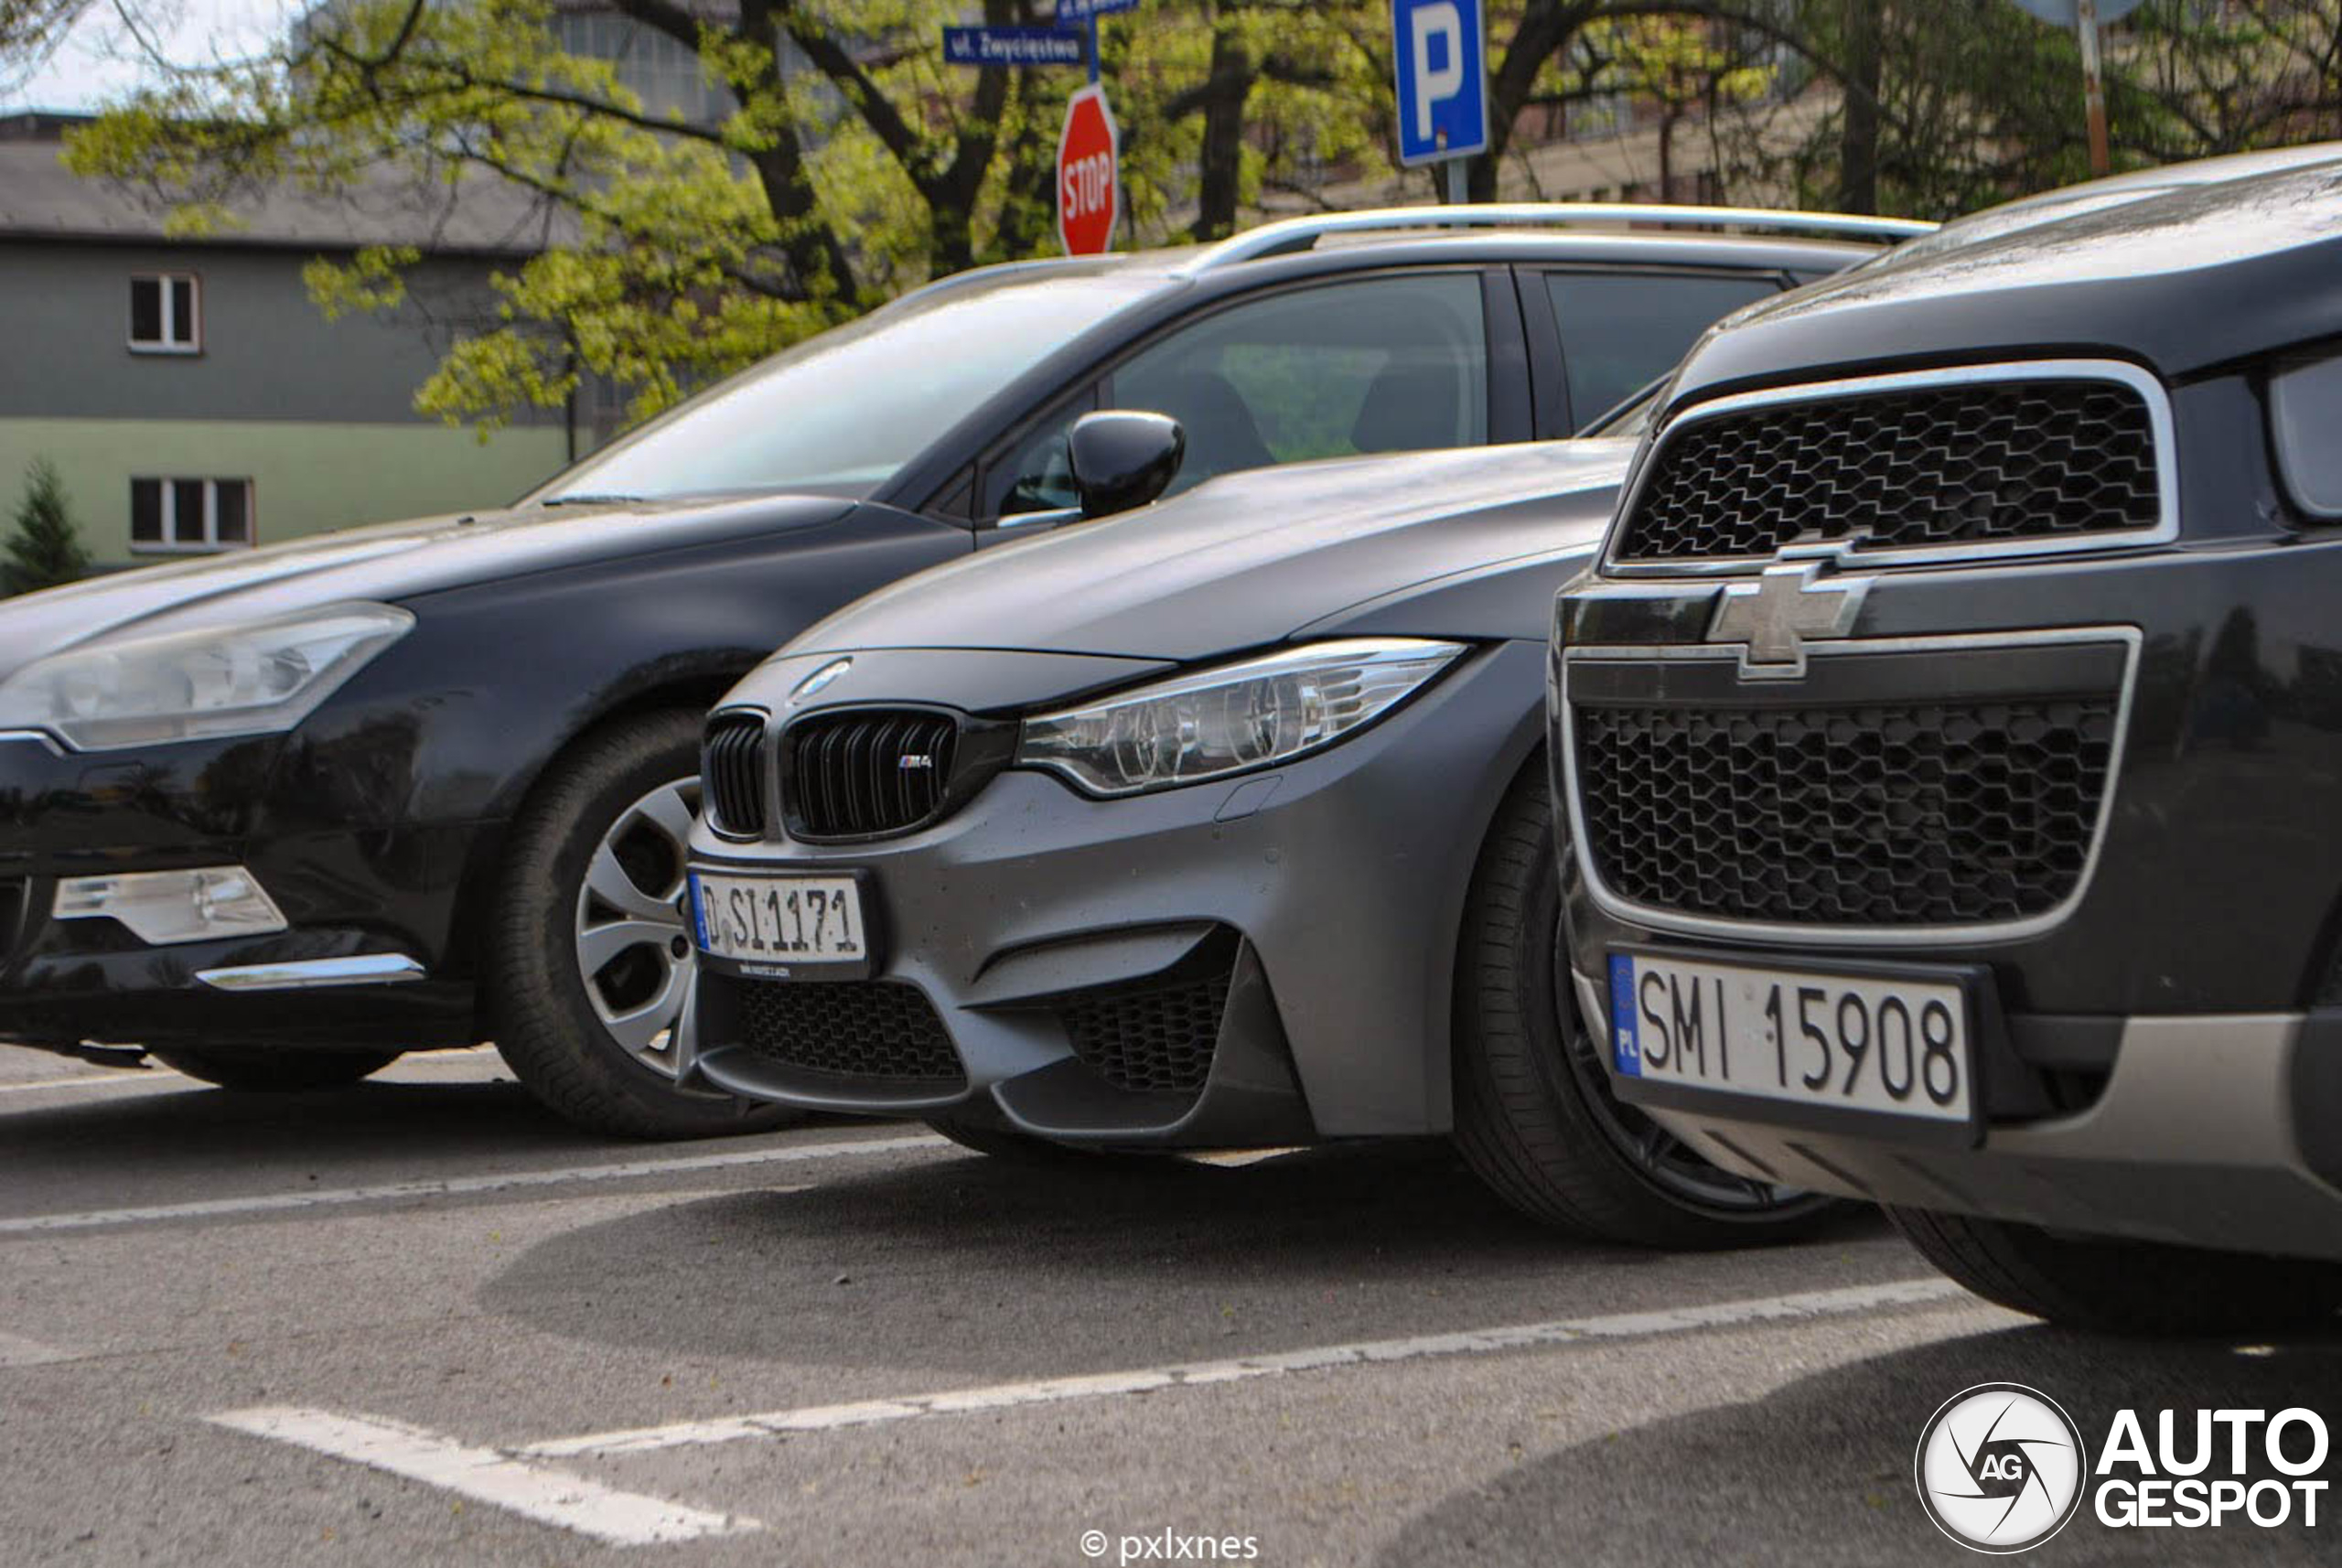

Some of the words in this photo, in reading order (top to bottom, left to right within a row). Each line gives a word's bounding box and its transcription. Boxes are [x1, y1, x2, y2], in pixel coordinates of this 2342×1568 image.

[1412, 3, 1463, 141] P
[1064, 152, 1111, 220] STOP
[1618, 1030, 1637, 1057] PL
[1639, 971, 1728, 1079] SMI
[1765, 983, 1958, 1106] 15908
